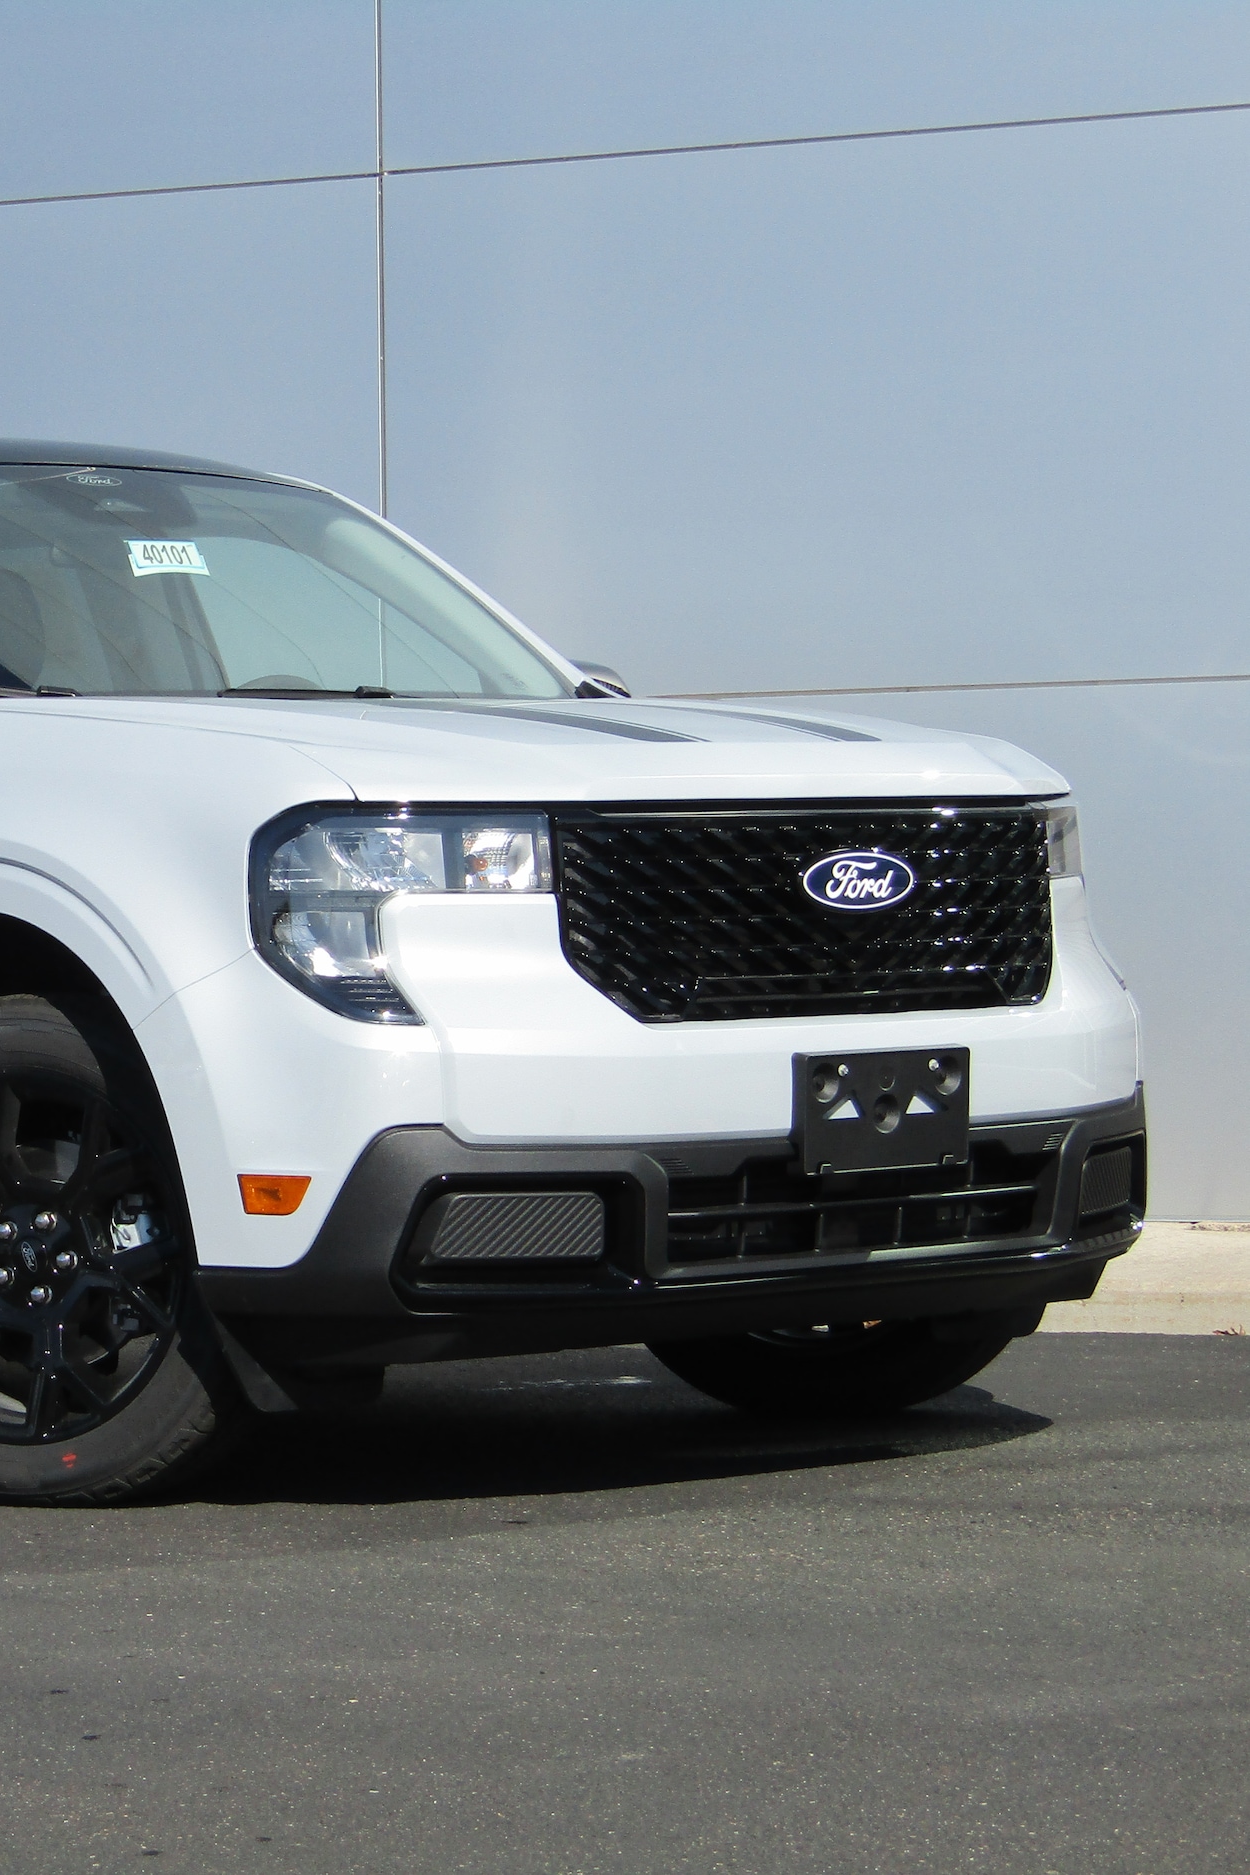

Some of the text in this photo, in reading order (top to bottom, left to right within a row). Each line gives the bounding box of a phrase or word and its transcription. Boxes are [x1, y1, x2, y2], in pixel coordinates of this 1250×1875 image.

[77, 475, 113, 486] Ford
[142, 544, 193, 565] 40101
[825, 860, 894, 899] Ford
